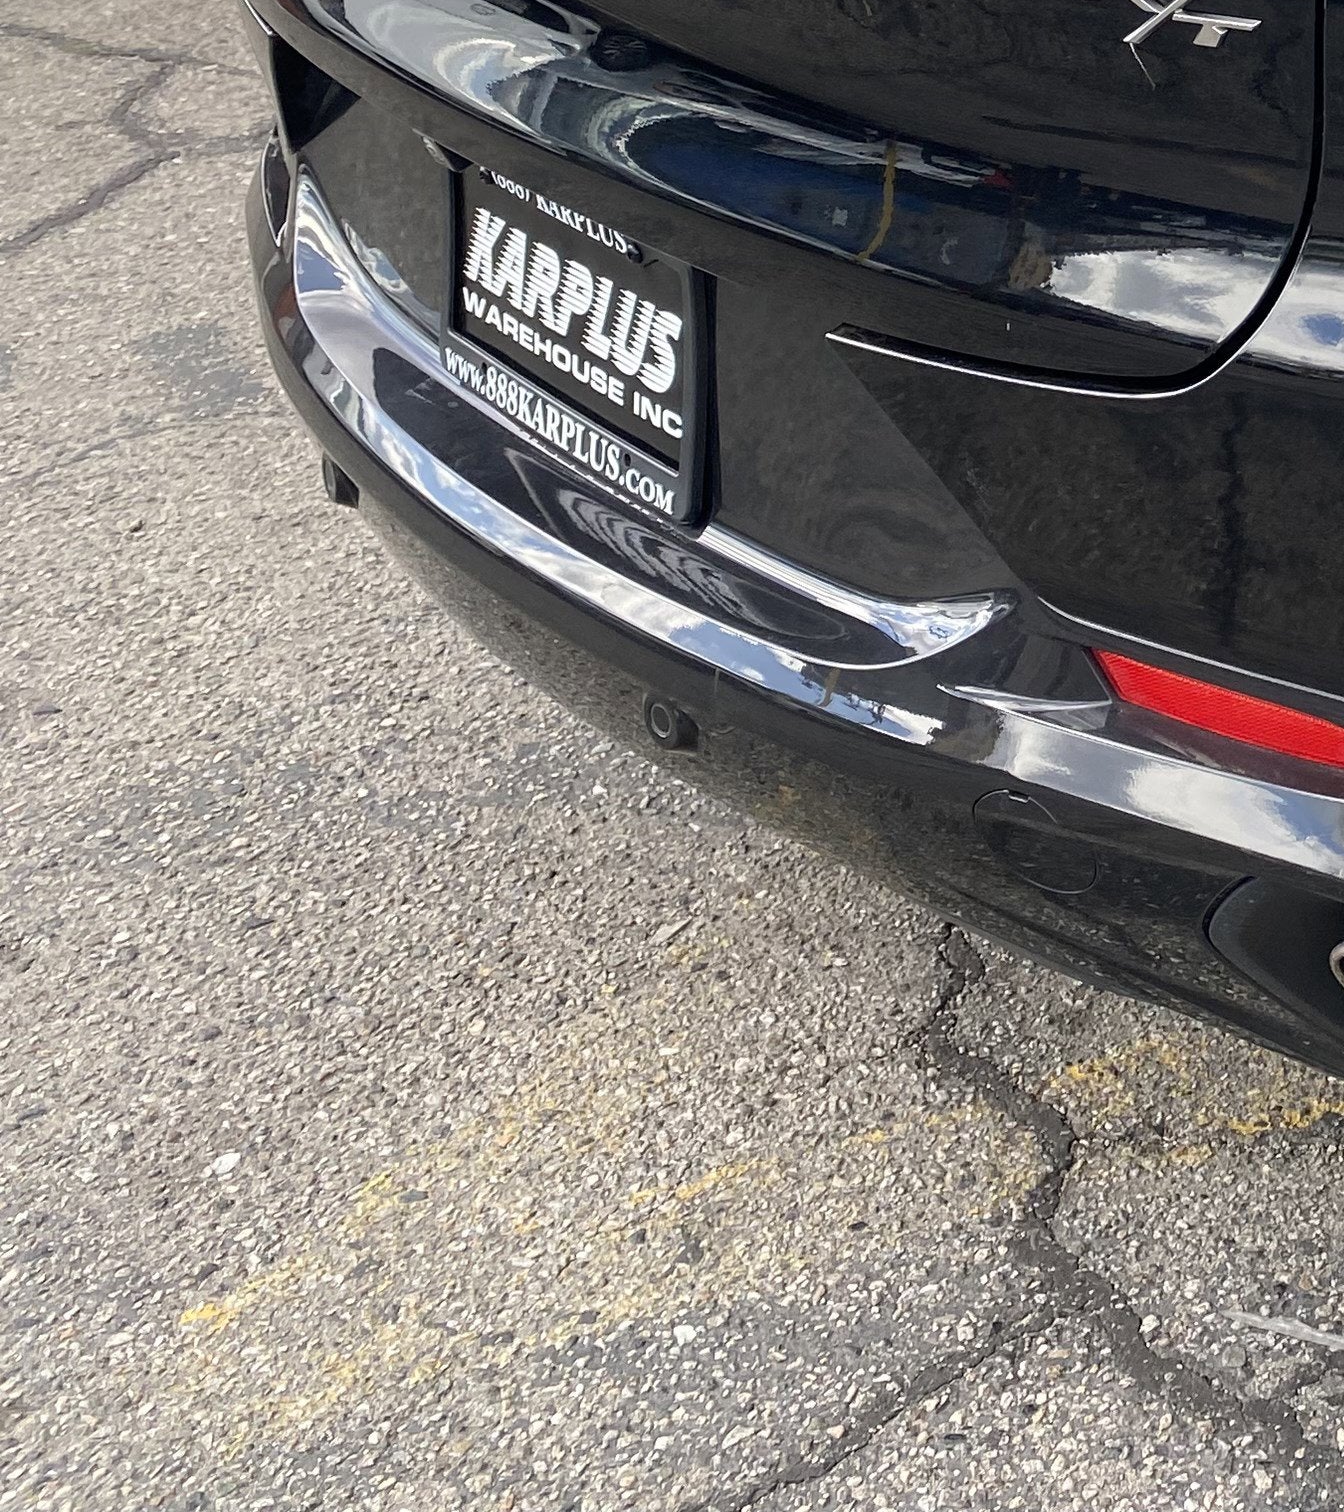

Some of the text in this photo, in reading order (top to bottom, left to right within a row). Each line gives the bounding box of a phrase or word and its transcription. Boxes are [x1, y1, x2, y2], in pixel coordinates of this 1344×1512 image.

[462, 287, 683, 439] WAREHOUSE INC
[463, 207, 683, 393] KARPLUS
